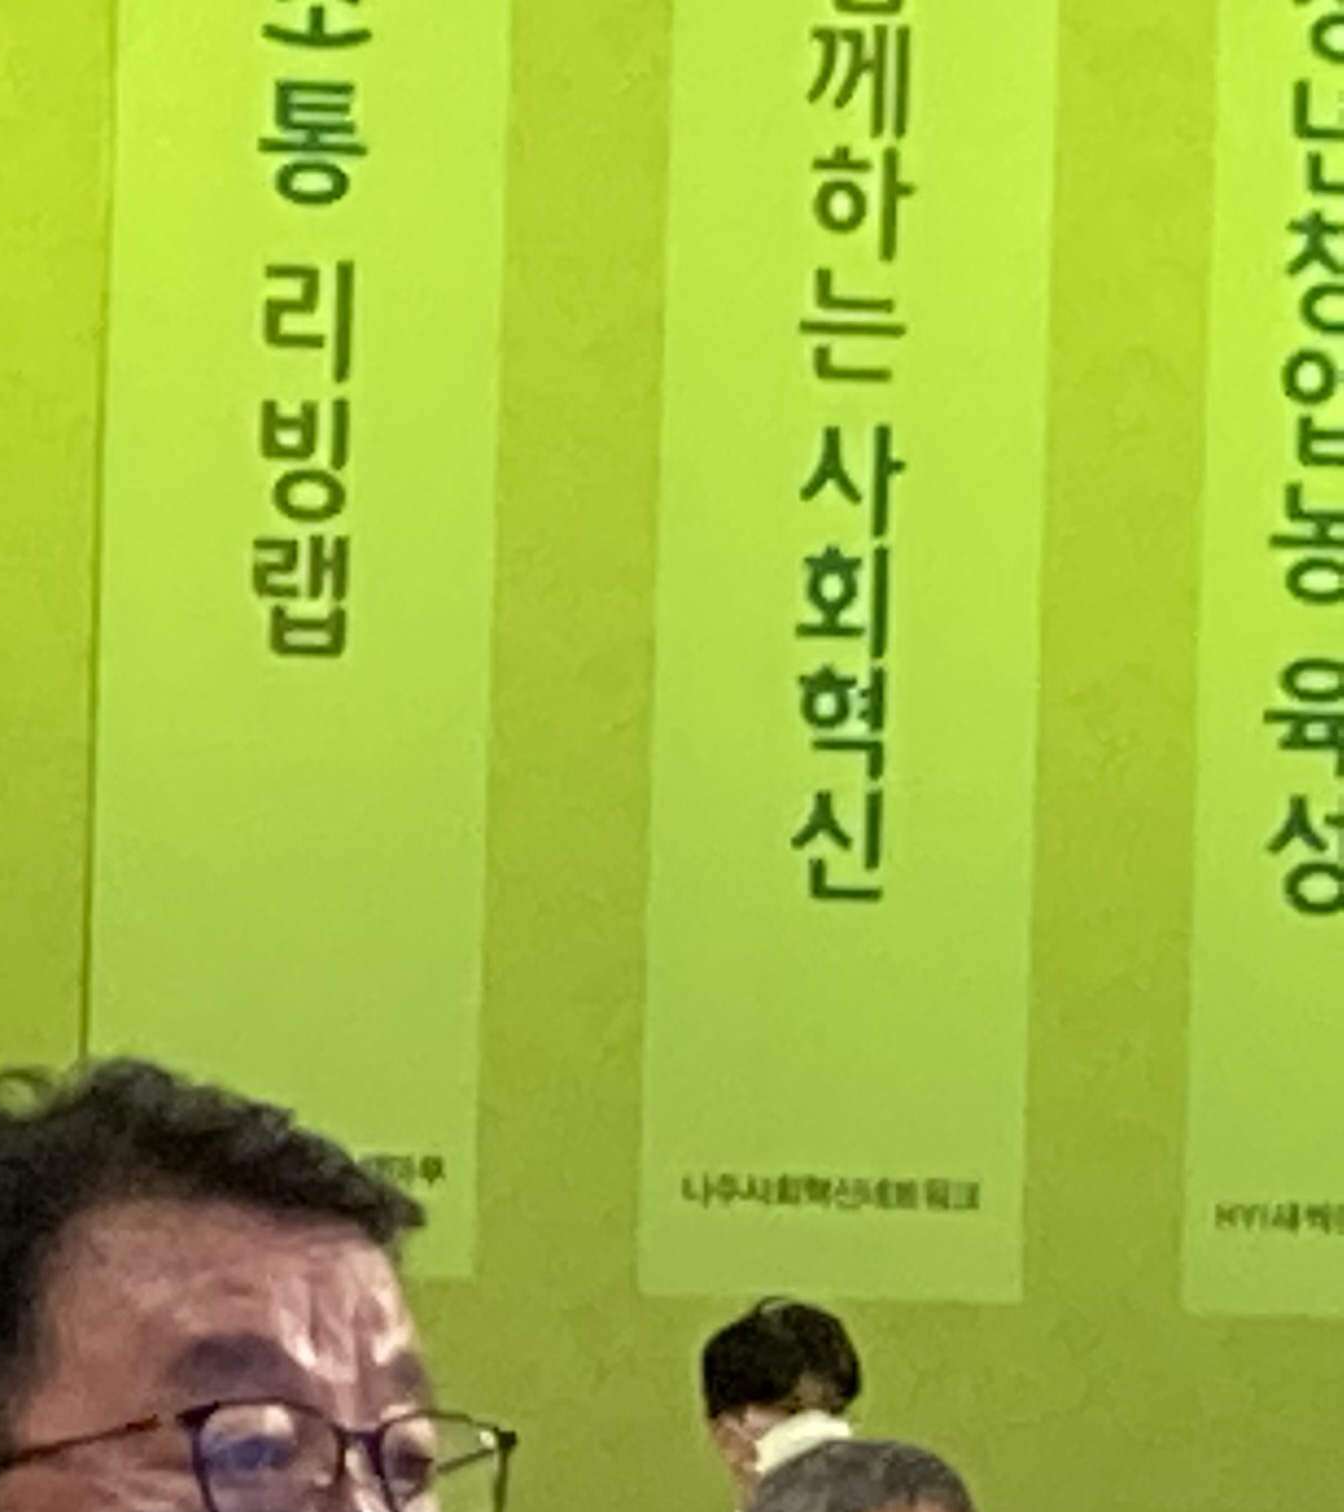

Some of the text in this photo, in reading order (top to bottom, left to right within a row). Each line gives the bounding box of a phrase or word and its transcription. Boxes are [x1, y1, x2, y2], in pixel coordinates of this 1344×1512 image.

[253, 260, 355, 658] 리빙랩
[790, 0, 916, 902] 께하는 사회혁신
